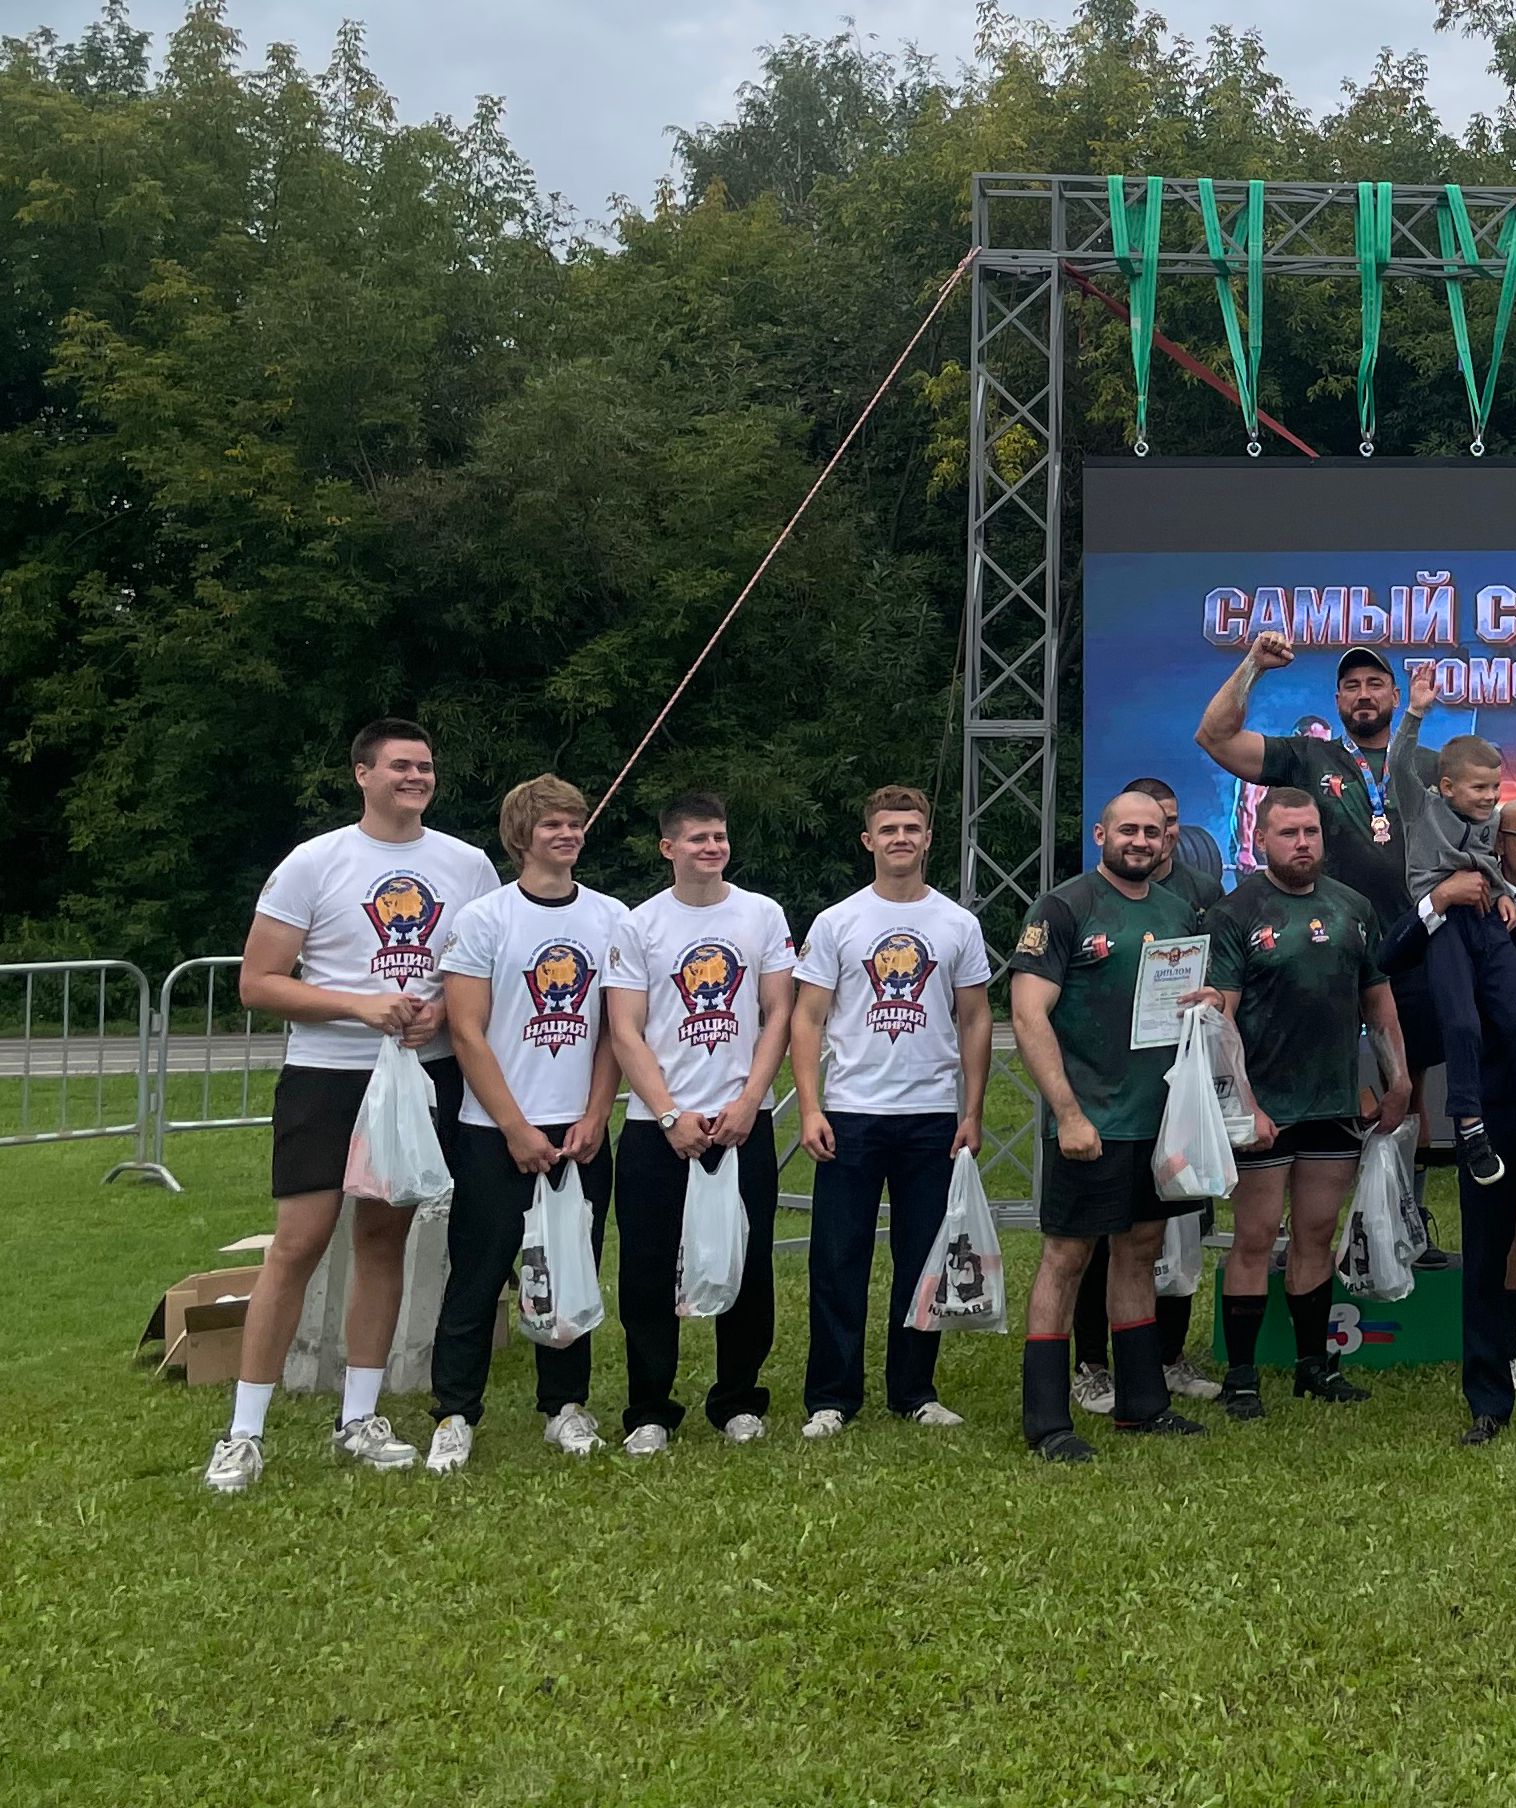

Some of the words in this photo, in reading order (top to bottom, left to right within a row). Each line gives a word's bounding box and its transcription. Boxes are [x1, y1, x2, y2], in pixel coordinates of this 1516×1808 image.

[1202, 571, 1457, 646] САМЫЙ
[372, 953, 432, 972] НАЦИЯ
[385, 966, 422, 977] МИРА
[868, 1008, 926, 1025] НАЦИЯ
[525, 1020, 586, 1039] НАЦИЯ
[680, 1018, 738, 1040] НАЦИЯ
[875, 1020, 914, 1032] МИРА
[537, 1033, 574, 1045] МИРА
[692, 1030, 730, 1045] МИРА
[1326, 1303, 1363, 1355] 3
